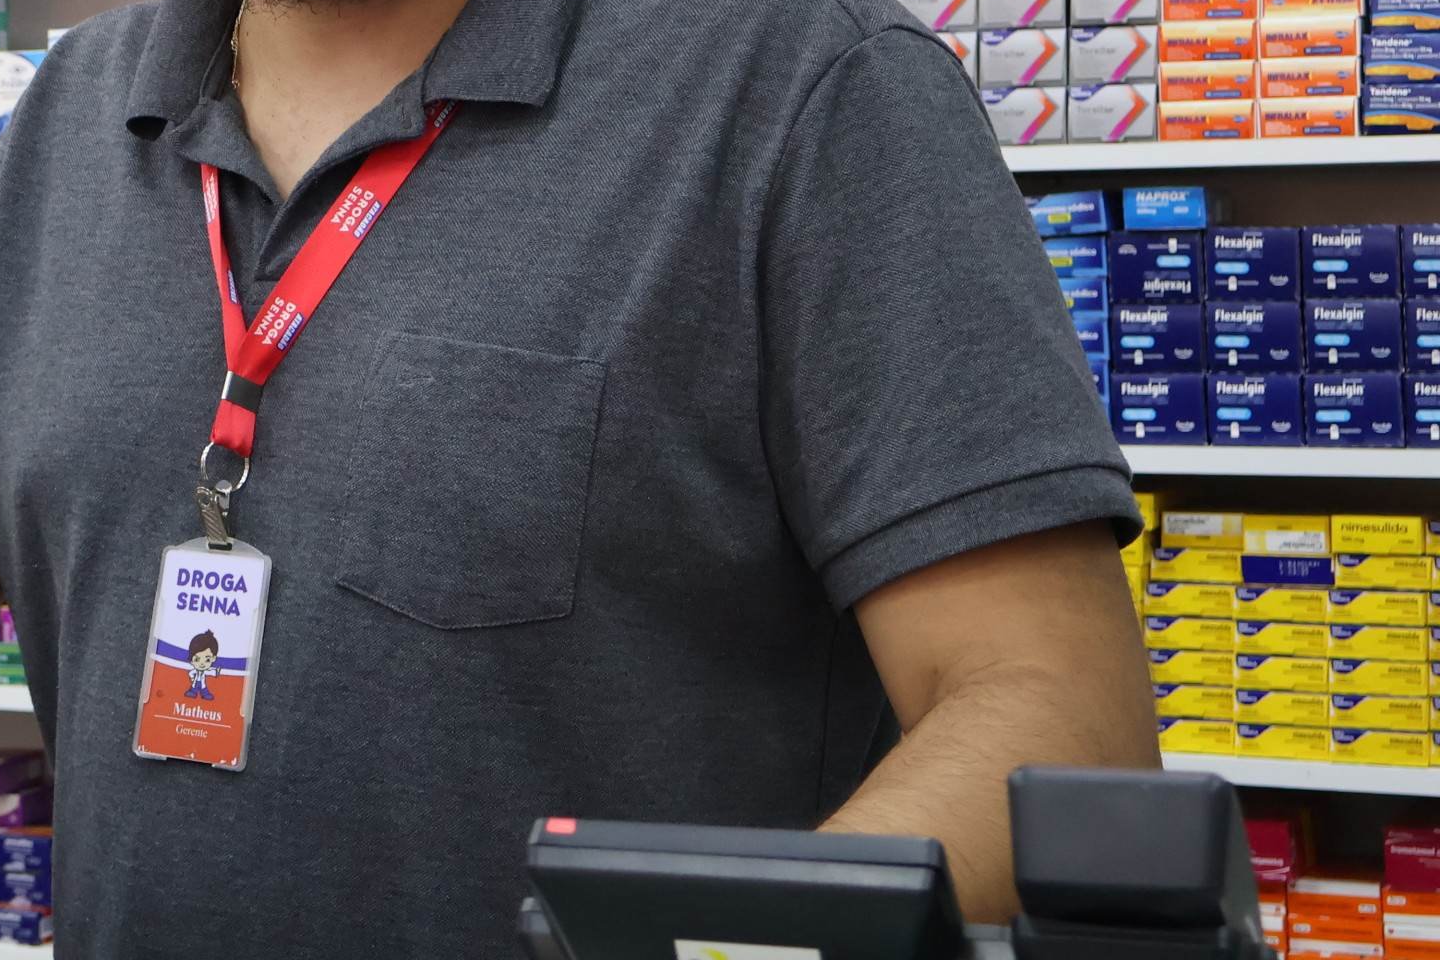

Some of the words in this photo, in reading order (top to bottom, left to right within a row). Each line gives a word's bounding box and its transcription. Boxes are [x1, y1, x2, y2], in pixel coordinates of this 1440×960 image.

[330, 185, 363, 224] SENNA
[1136, 192, 1186, 202] NAPROX
[339, 190, 374, 232] DROGA
[1214, 235, 1263, 251] Flexalgin
[1312, 233, 1361, 249] Flexalgin
[1413, 233, 1440, 246] Flexa
[254, 297, 285, 336] SENNA
[1120, 309, 1168, 325] Flexalgin
[1215, 309, 1264, 325] Flexalgin
[1314, 307, 1364, 323] Flexalgin
[1416, 308, 1440, 320] Flexa
[262, 301, 297, 345] DROGA
[1121, 382, 1169, 398] Flexalgin
[1216, 381, 1265, 397] Flexalgin
[1314, 383, 1364, 399] Flexalgin
[1414, 382, 1440, 395] Flexa
[1341, 521, 1408, 534] nimesulida
[176, 568, 248, 593] DROGA
[176, 592, 241, 617] SENNA
[173, 701, 222, 722] Matheus
[175, 724, 208, 738] Gerente
